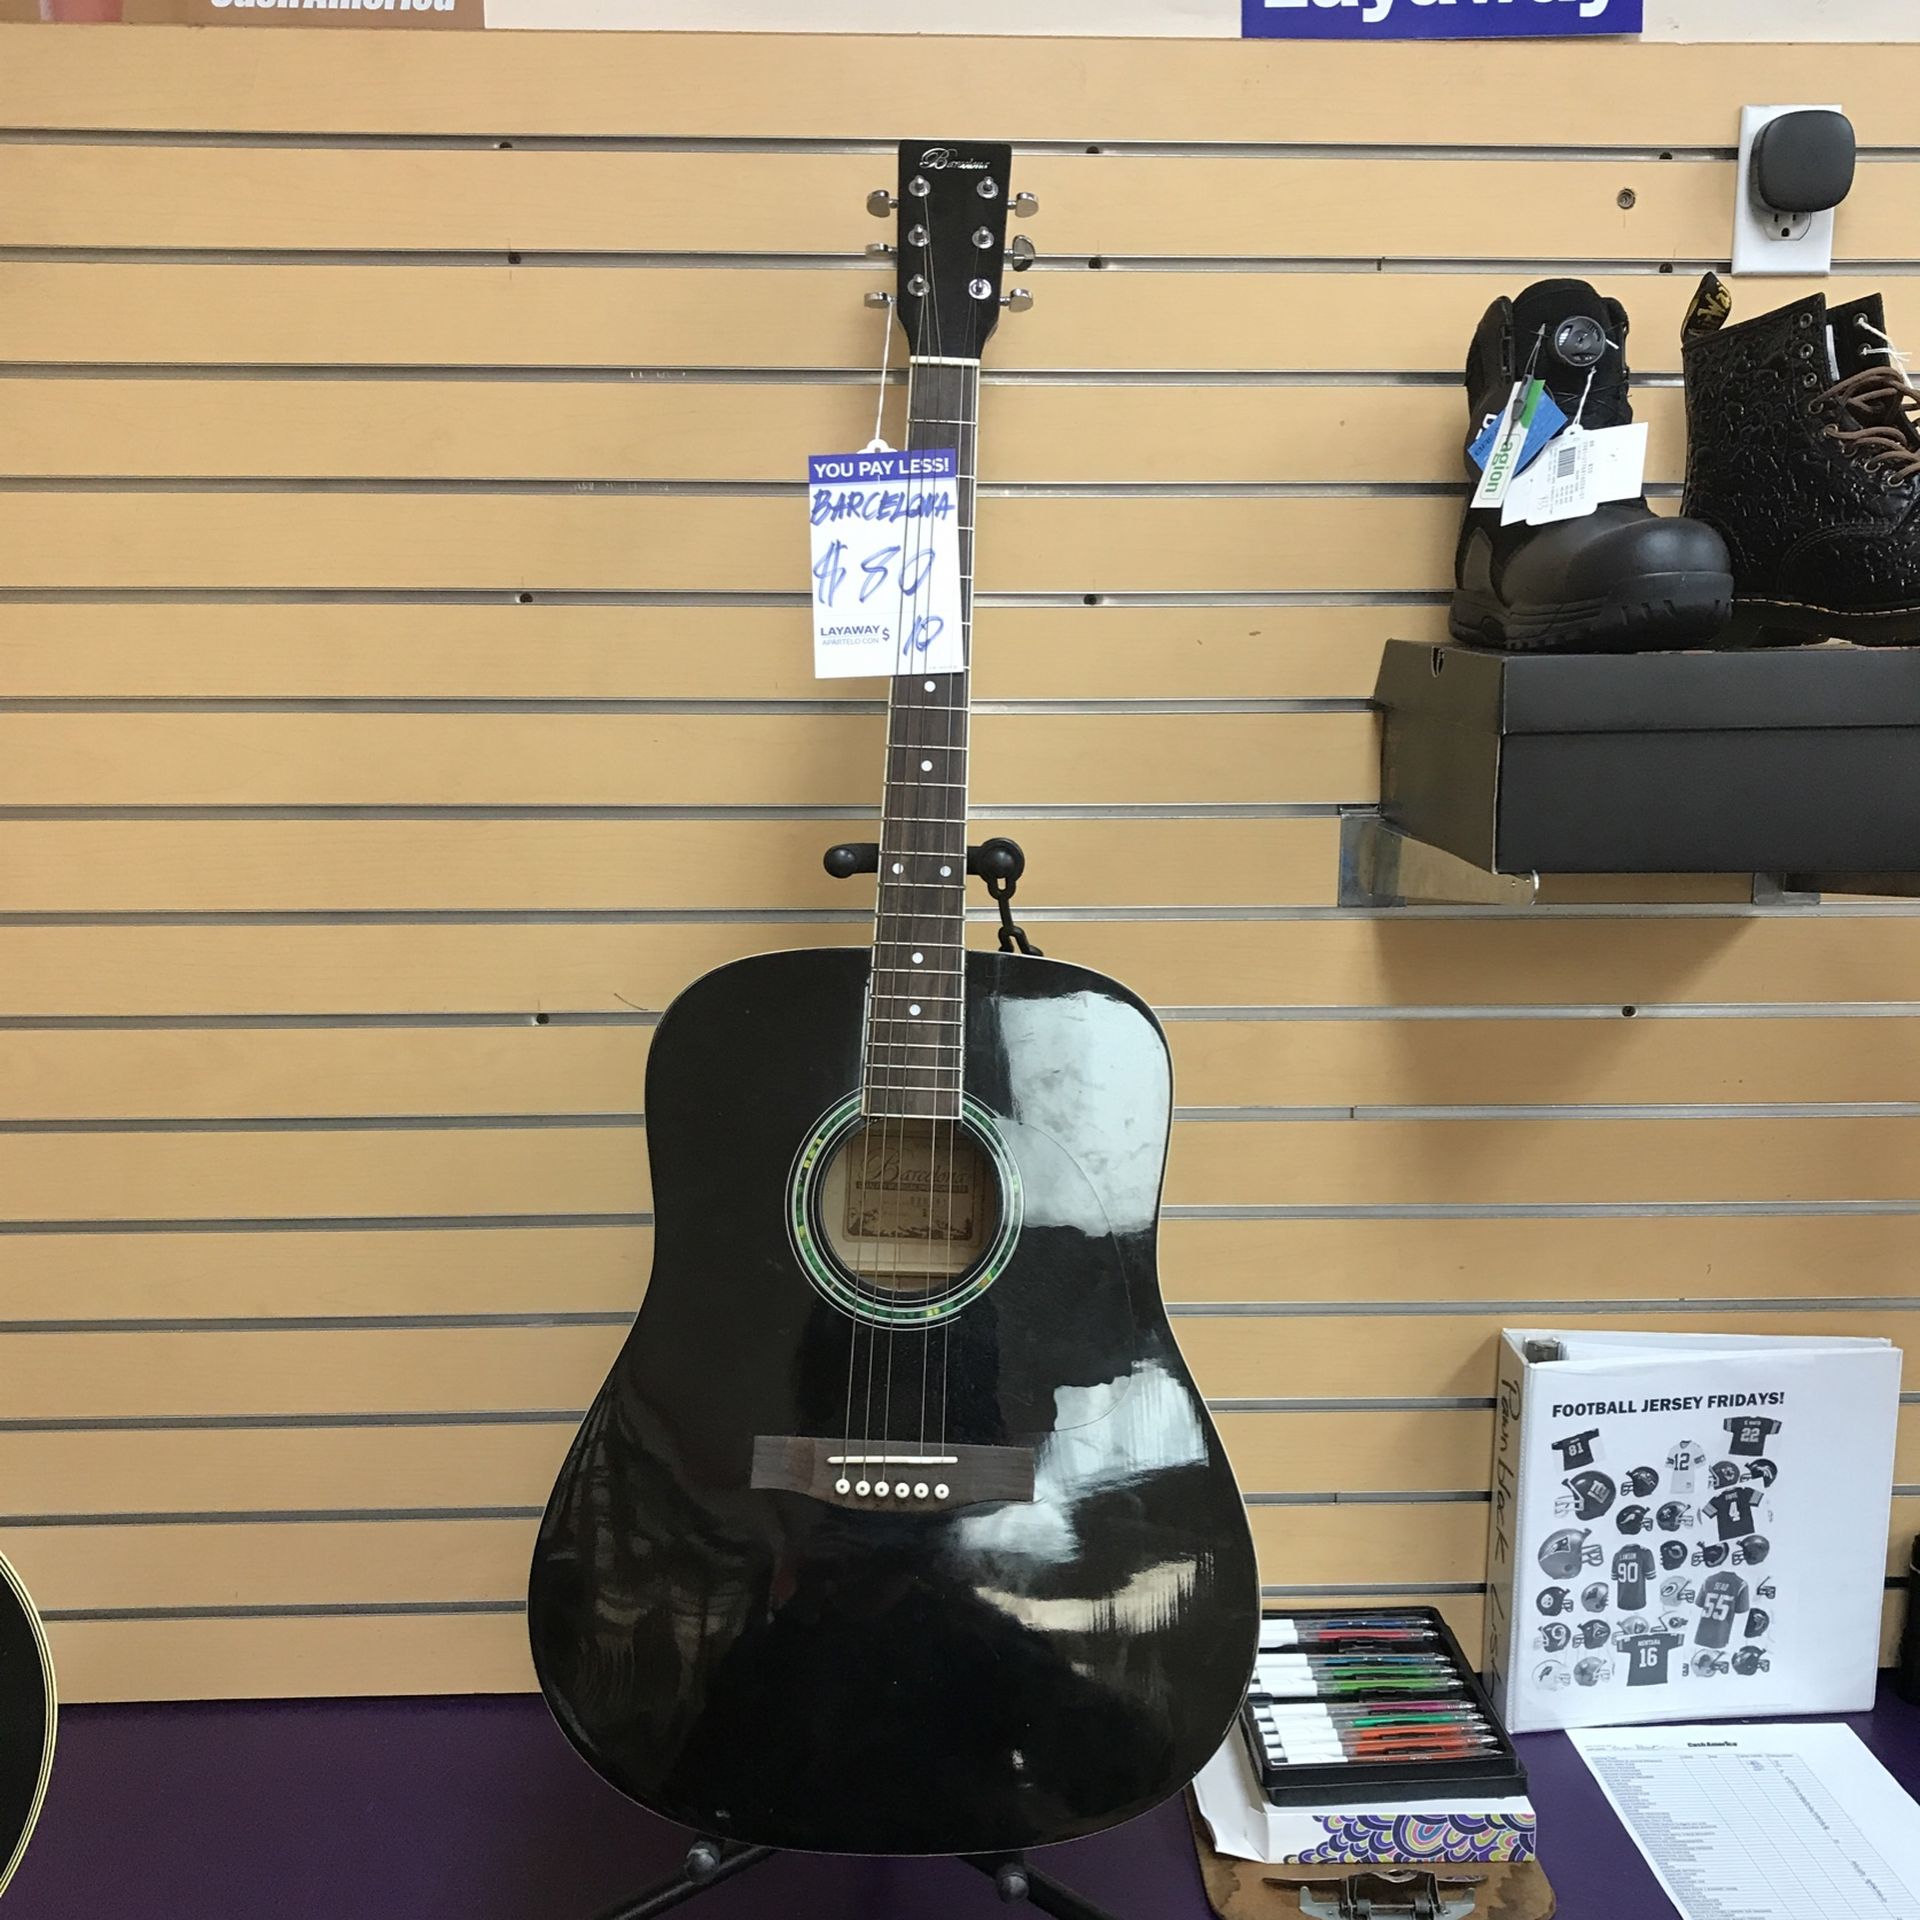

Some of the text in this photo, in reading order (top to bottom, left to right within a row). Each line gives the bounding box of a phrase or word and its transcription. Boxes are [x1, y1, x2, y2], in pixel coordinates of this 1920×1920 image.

[814, 458, 949, 479] YOU PAY LESS!
[810, 488, 956, 526] BARCELONA
[820, 625, 880, 637] LAYAWAY
[1552, 1391, 1785, 1418] FOOTBALL JERSEY FRIDAYS!
[1740, 1427, 1760, 1442] 22
[1568, 1441, 1584, 1456] 81
[1673, 1452, 1691, 1471] 12
[1728, 1501, 1741, 1522] 4
[1617, 1562, 1638, 1582] 90
[1702, 1593, 1735, 1621] 55
[1639, 1646, 1658, 1667] 16
